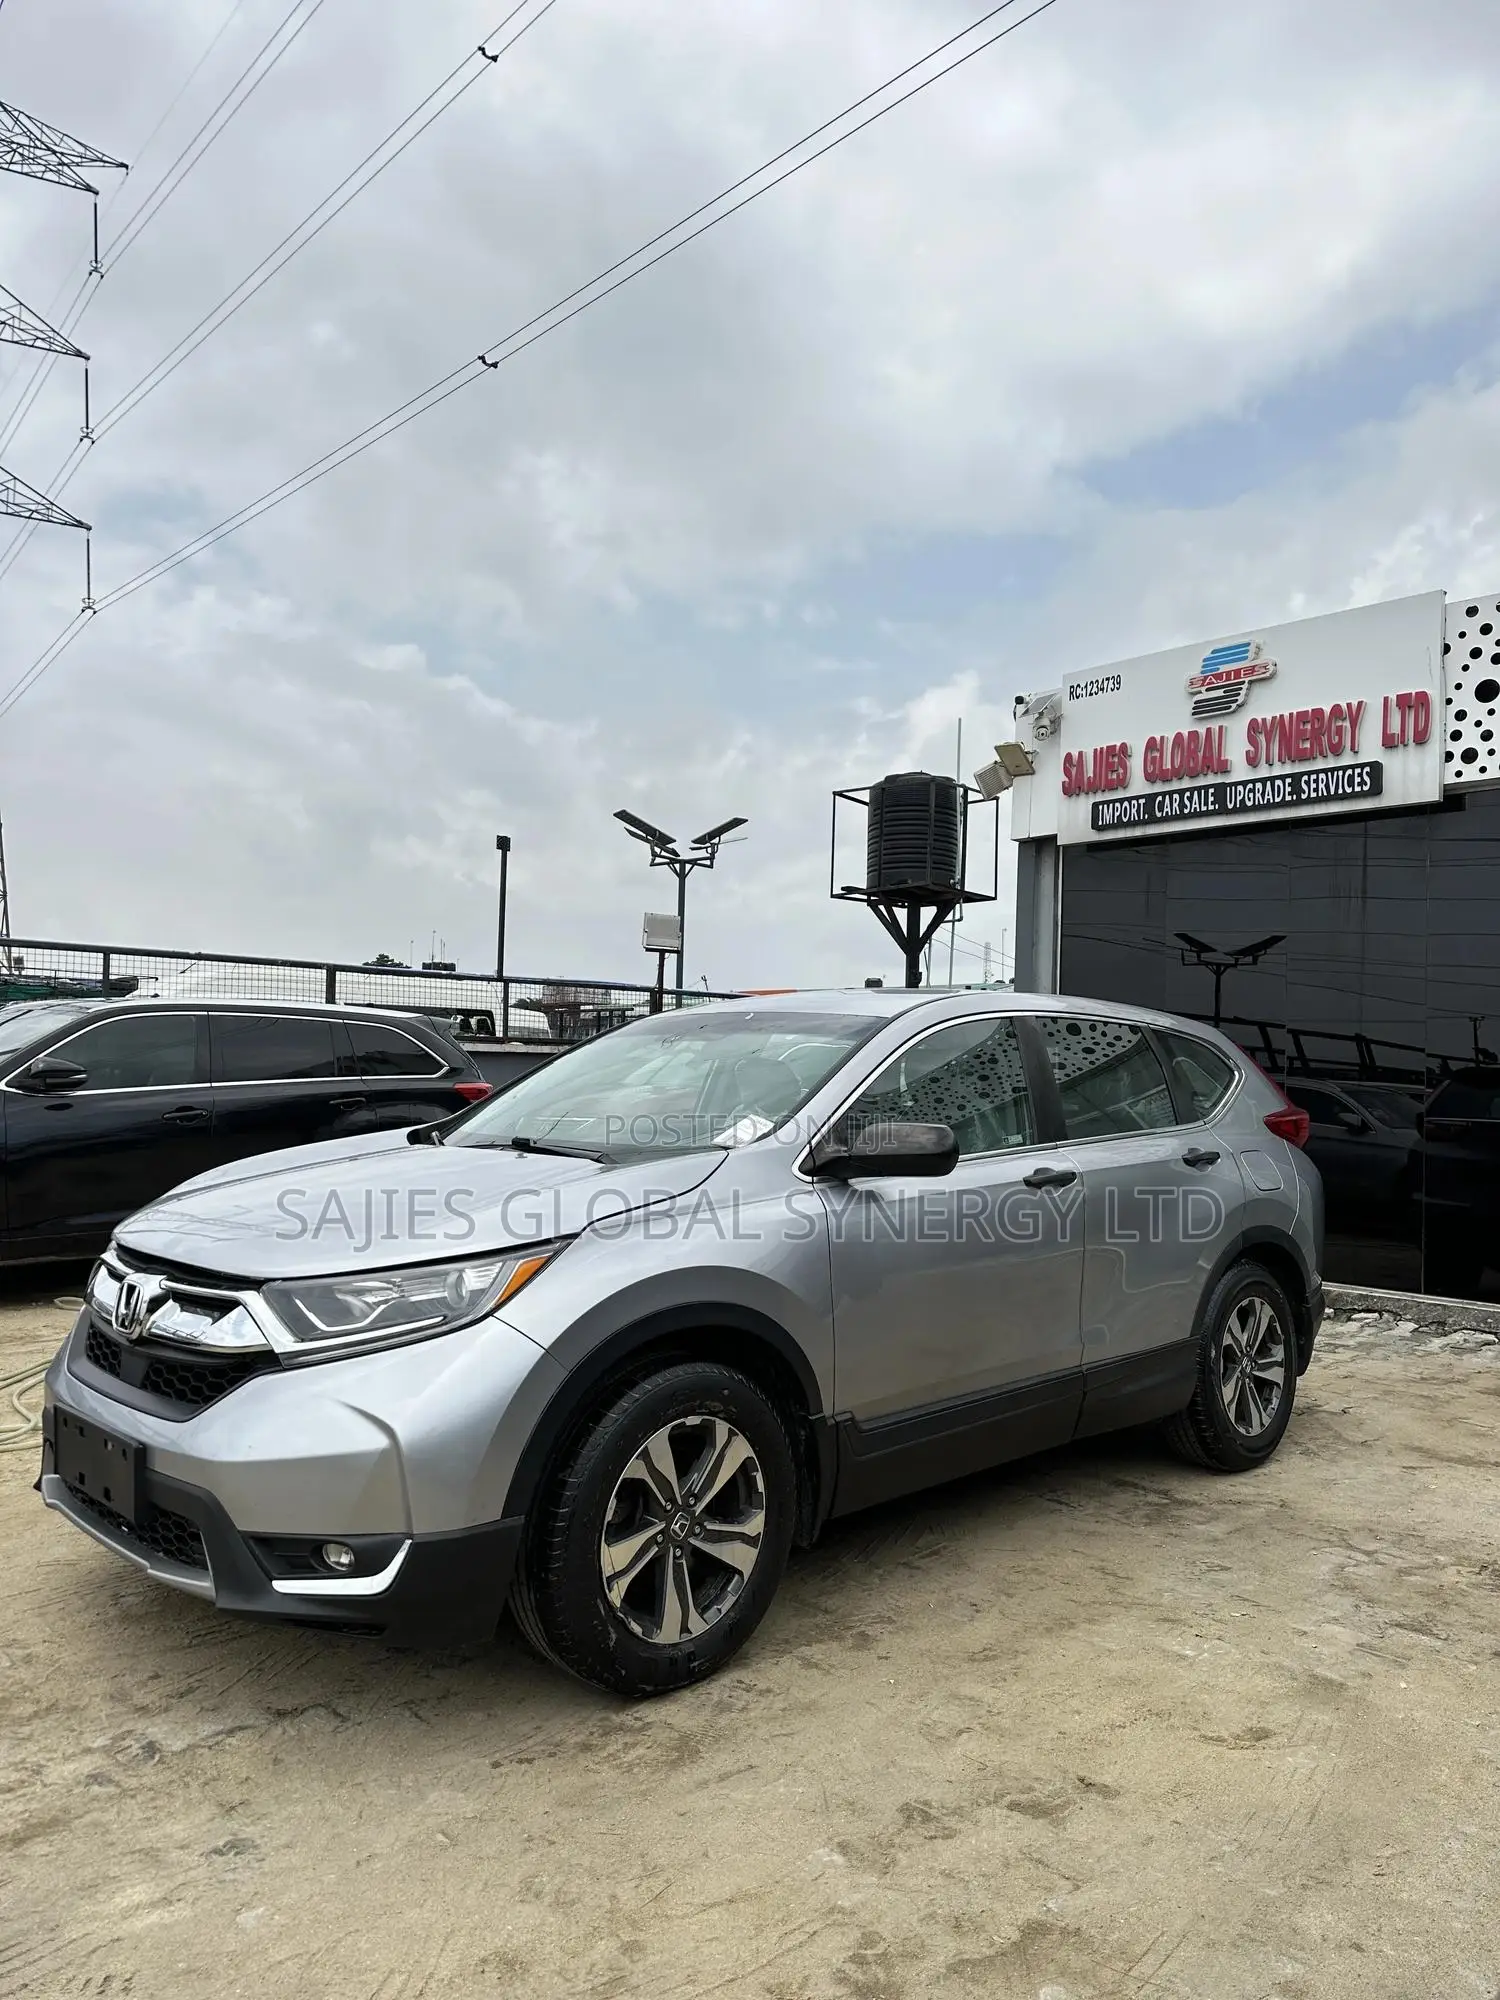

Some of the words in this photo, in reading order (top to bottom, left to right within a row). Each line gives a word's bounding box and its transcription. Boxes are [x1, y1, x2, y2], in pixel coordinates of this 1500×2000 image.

[1069, 674, 1122, 700] RC:1234739
[1189, 662, 1271, 688] SAJIES
[1062, 742, 1132, 796] SAJIES
[1143, 725, 1231, 783] GLOBAL
[1245, 700, 1366, 768] SYNERGY
[1381, 690, 1432, 748] LTD
[1098, 798, 1148, 826] IMPORT.
[1154, 793, 1180, 818] CAR
[1183, 787, 1219, 814] SALE.
[1226, 776, 1297, 809] UPGRADE.
[1301, 766, 1371, 799] SERVICES
